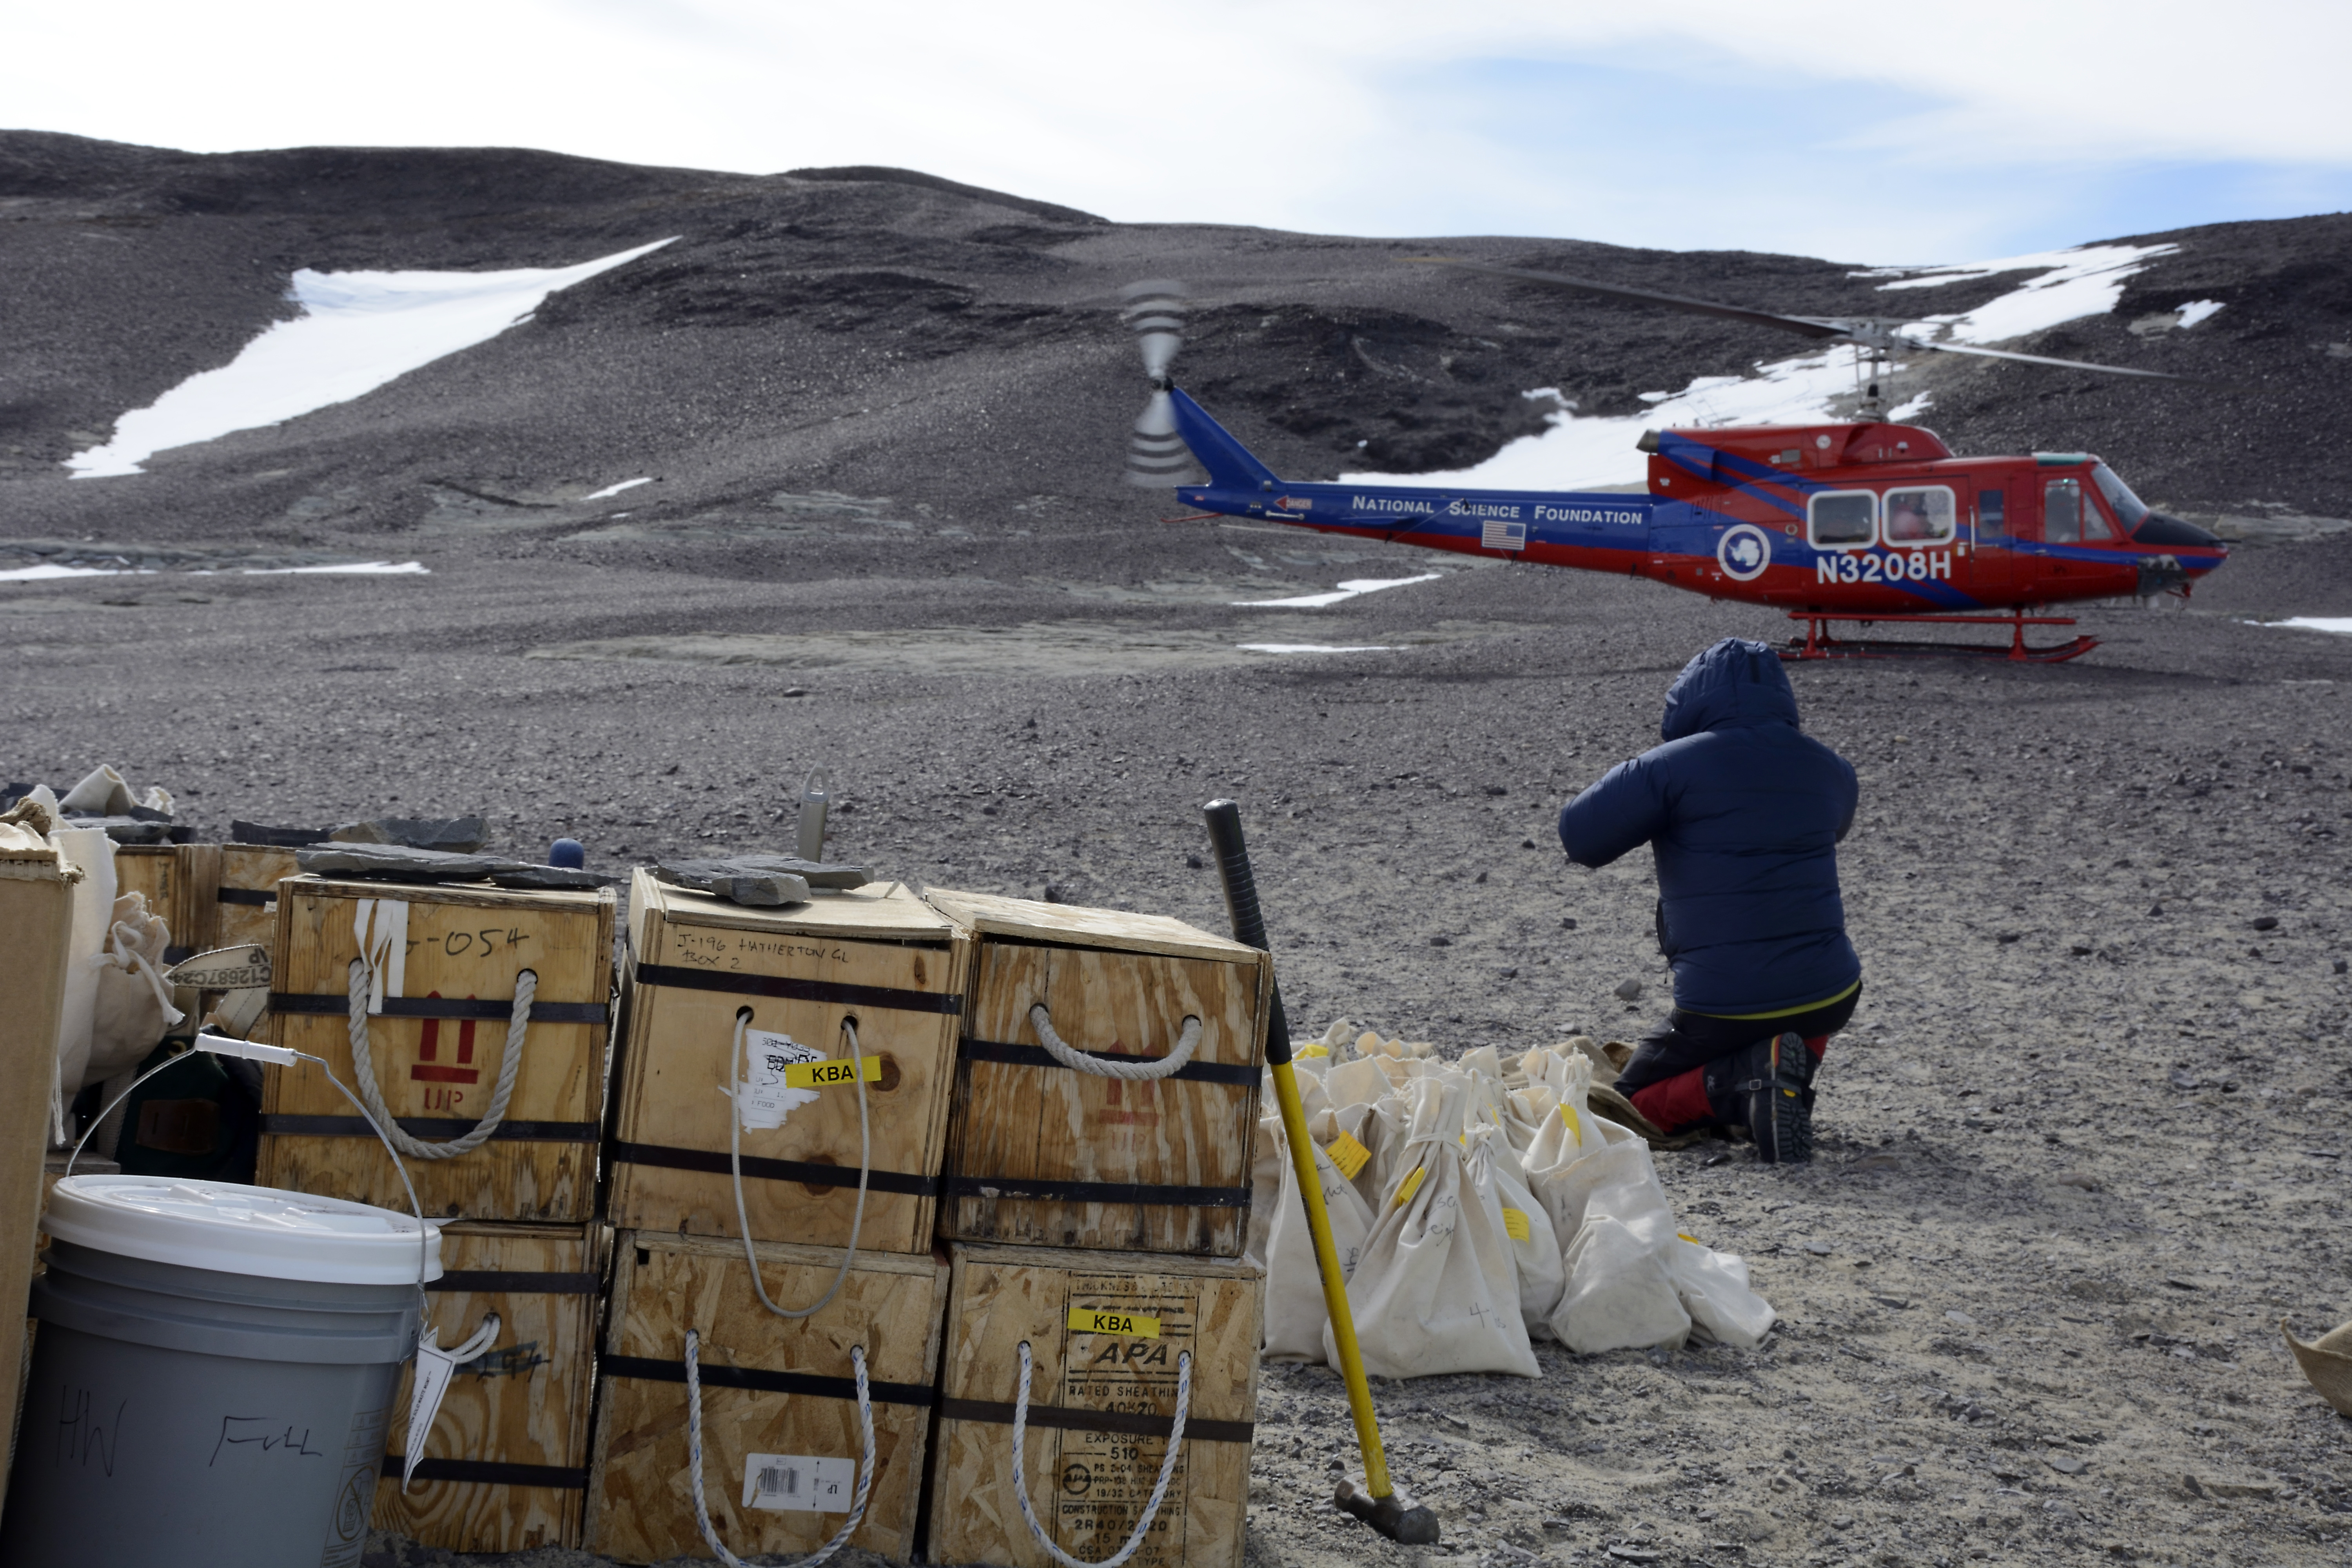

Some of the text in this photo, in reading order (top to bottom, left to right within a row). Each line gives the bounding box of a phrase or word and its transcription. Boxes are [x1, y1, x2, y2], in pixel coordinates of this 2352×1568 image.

[1353, 496, 1642, 524] NATIONAL SCIENCE FOUNDATION
[1817, 551, 1951, 584] N3208H
[683, 949, 741, 969] BOX 2
[812, 1065, 854, 1082] KBA
[425, 1087, 463, 1111] UP
[1093, 1315, 1133, 1332] KBA
[1094, 1343, 1167, 1365] APA
[1069, 1386, 1178, 1397] RATED SHEATHIN
[1085, 1433, 1153, 1445] EXPOSURE
[1111, 1447, 1138, 1461] 510
[827, 1485, 838, 1494] LP
[1062, 1505, 1128, 1515] CONSTRUCTION
